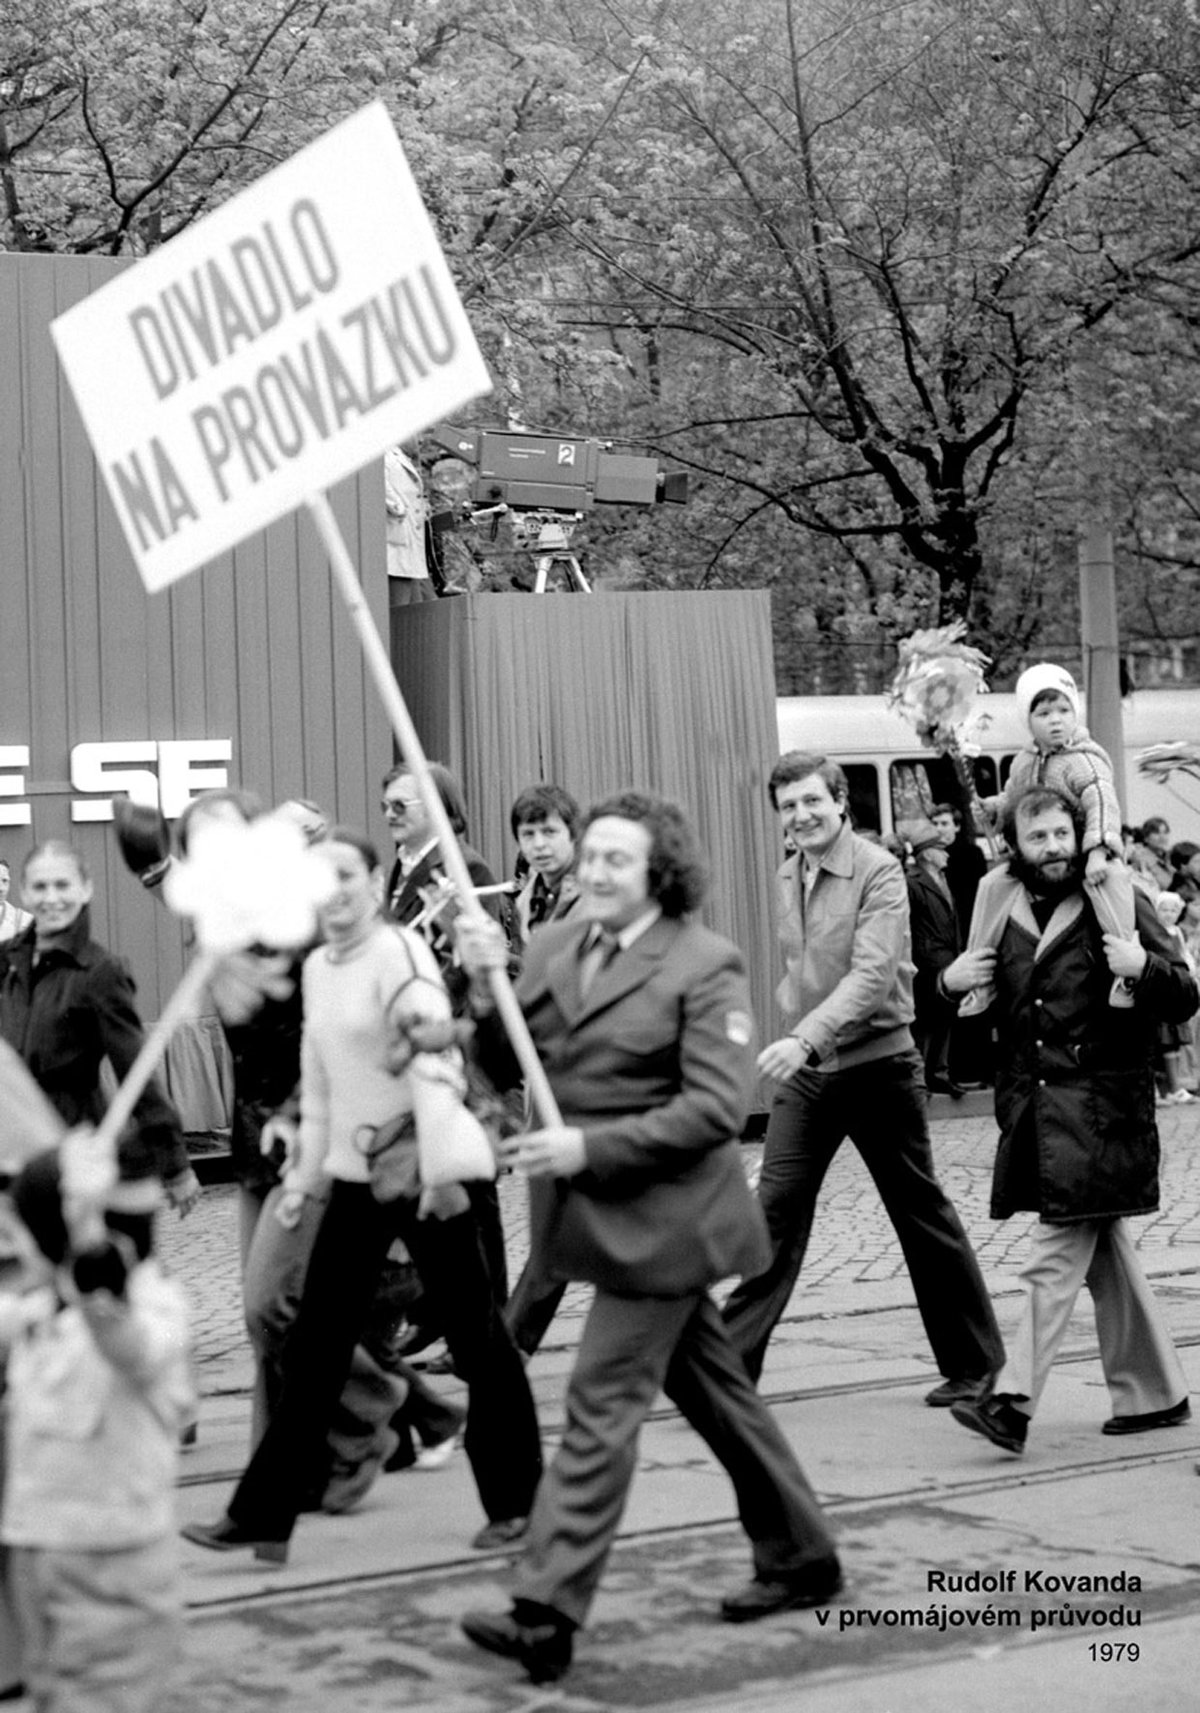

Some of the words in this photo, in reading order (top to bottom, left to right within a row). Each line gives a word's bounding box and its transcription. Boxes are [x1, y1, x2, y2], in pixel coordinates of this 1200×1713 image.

[129, 199, 339, 401] DIVADLO
[111, 435, 200, 551] NA
[559, 445, 574, 467] 2
